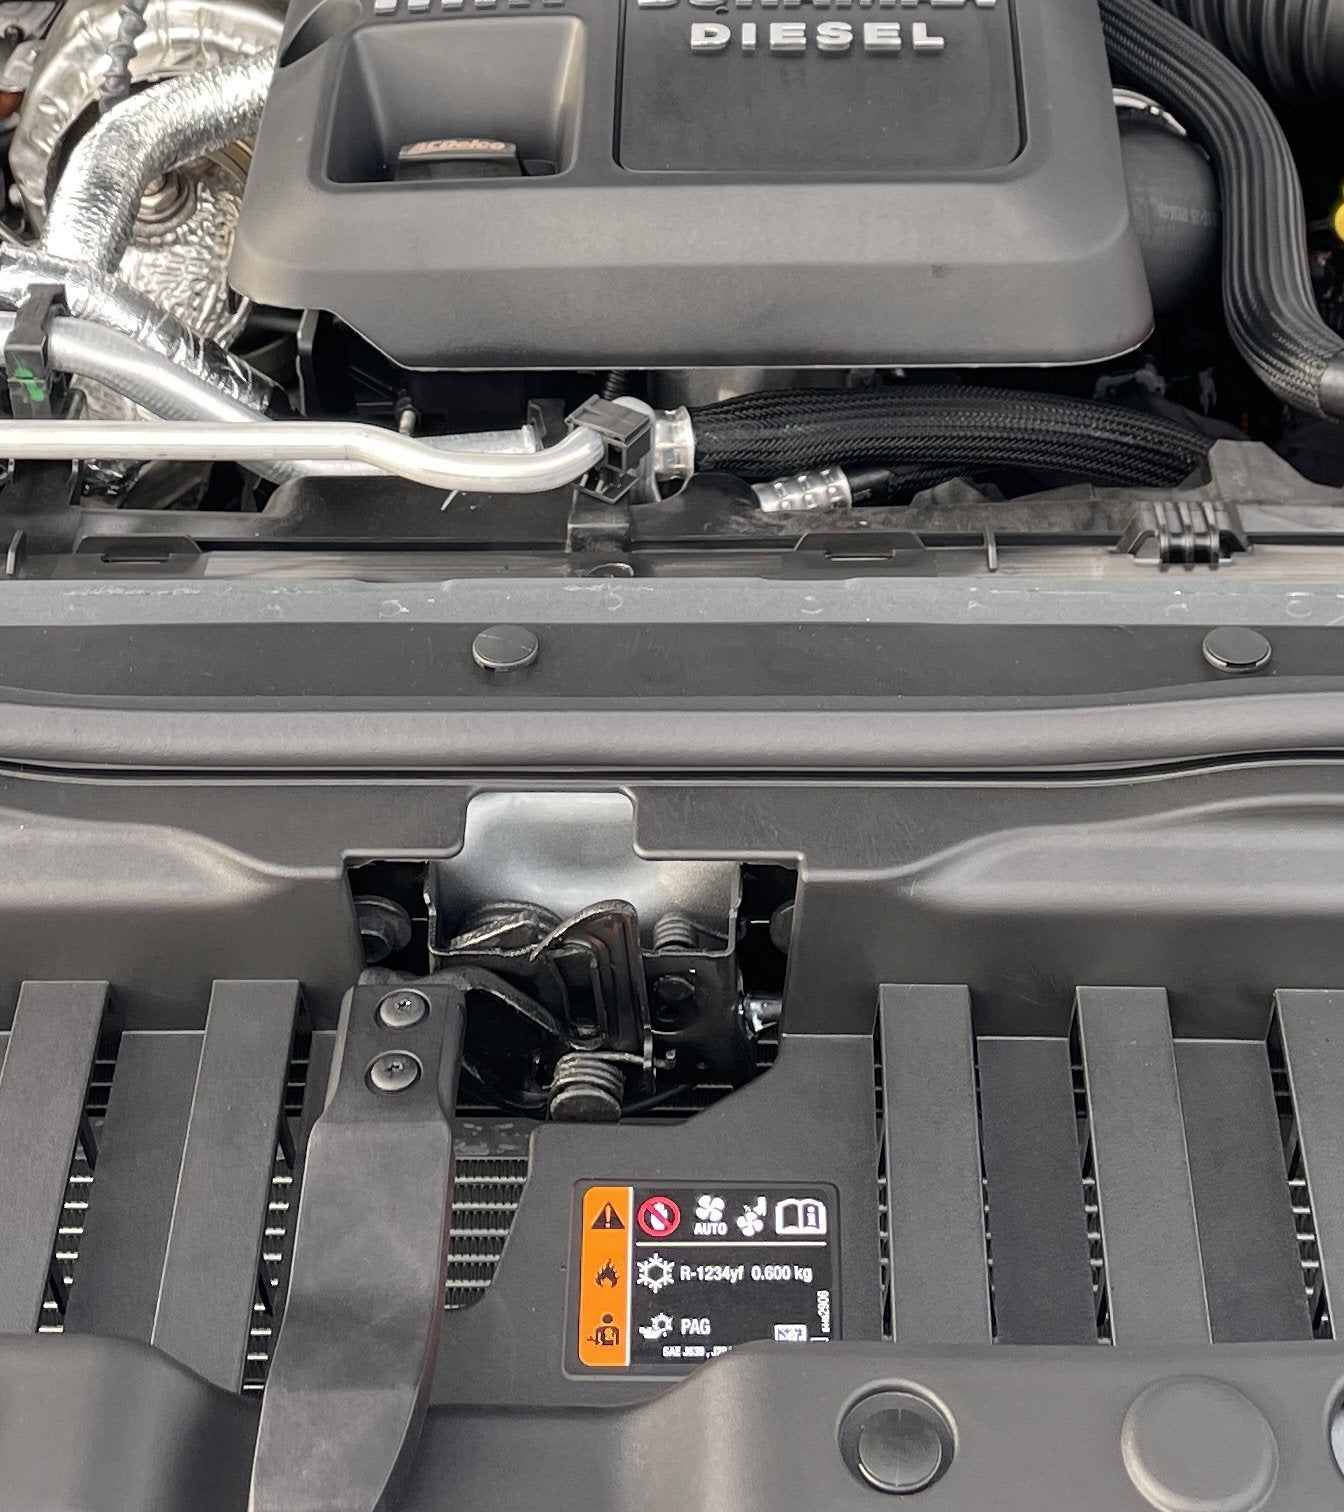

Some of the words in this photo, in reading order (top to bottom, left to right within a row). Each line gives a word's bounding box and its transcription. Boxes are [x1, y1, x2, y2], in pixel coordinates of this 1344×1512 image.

[690, 21, 945, 51] DIESEL
[407, 139, 506, 155] ACDelco
[693, 1222, 728, 1236] AUTO
[679, 1265, 745, 1284] R-1234yf
[751, 1265, 792, 1282] 0.600
[794, 1265, 813, 1283] kg
[680, 1318, 711, 1336] PAG
